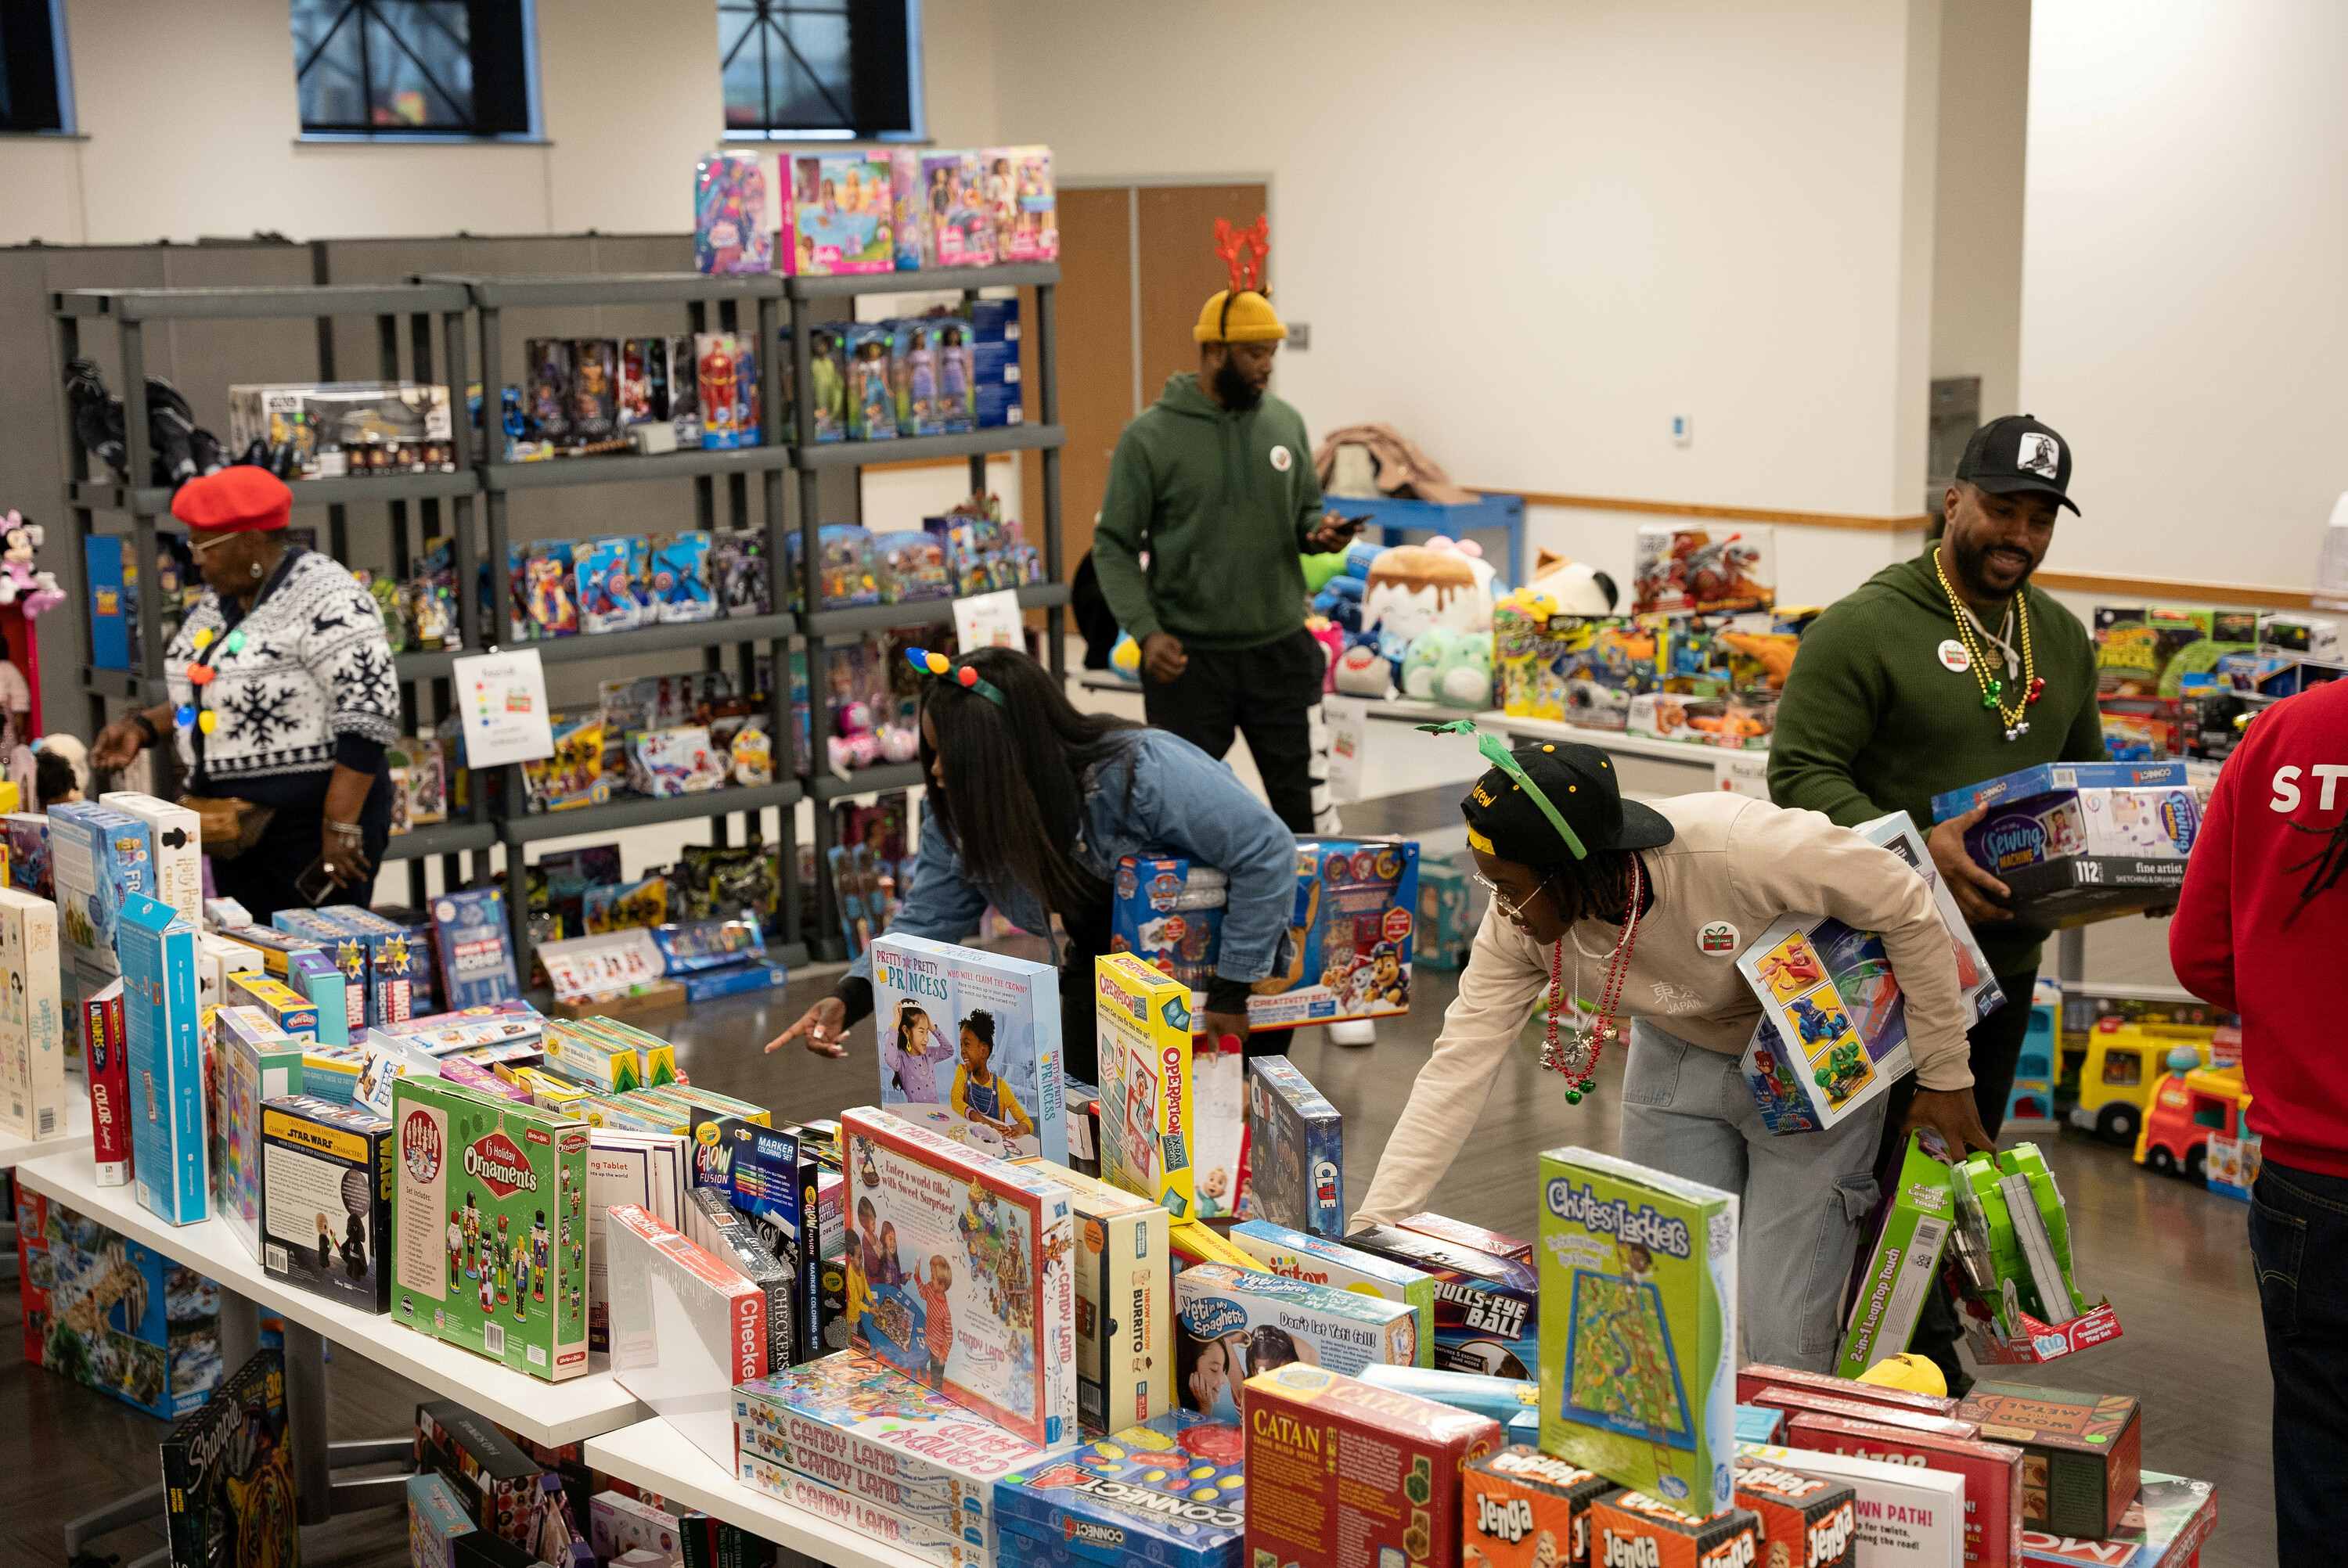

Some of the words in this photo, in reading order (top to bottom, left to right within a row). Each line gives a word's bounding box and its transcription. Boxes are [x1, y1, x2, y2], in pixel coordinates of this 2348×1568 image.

[1473, 781, 1496, 807] drew
[2167, 789, 2190, 855] Sewing
[1987, 825, 2045, 858] Sewing
[1999, 848, 2034, 868] MACHINE
[2076, 861, 2099, 883] 112
[2136, 862, 2154, 873] fine
[2157, 863, 2183, 874] artist
[2116, 875, 2149, 884] SKETCHING
[877, 950, 902, 966] PRETTY
[913, 958, 938, 975] PRETTY
[888, 966, 948, 1000] PRINCESS
[946, 969, 959, 978] WHO
[961, 971, 973, 980] WILL
[976, 975, 992, 985] CLAIM
[994, 978, 1003, 987] THE
[1005, 981, 1027, 994] CROWN?
[1100, 973, 1133, 1015] OPERATION
[347, 984, 363, 1027] MARVEL
[378, 981, 387, 1026] CROCHET
[394, 980, 411, 1023] MARVEL
[1667, 1000, 1702, 1015] JAPAN
[93, 1084, 113, 1125] COLOR
[1041, 1064, 1055, 1121] PRINCESS
[1055, 1087, 1064, 1109] PRETTY
[1162, 1047, 1181, 1136] OPERATION
[287, 1128, 310, 1142] STAR
[310, 1135, 333, 1149] WARS
[333, 1145, 362, 1158] CHARACTERS
[486, 1139, 492, 1156] 6
[494, 1144, 516, 1164] Holiday
[556, 1142, 590, 1153] Ornaments
[758, 1136, 794, 1155] MARKER
[758, 1145, 781, 1159] COLORING
[783, 1153, 793, 1162] SET
[1164, 1137, 1172, 1160] MATCH
[1172, 1138, 1182, 1166] X-RAY
[463, 1145, 538, 1193] Ornaments
[603, 1162, 628, 1171] Tablet
[697, 1143, 733, 1174] GLOW
[700, 1174, 729, 1185] FUSION
[885, 1159, 905, 1178] Enter
[910, 1174, 931, 1190] world
[932, 1180, 950, 1199] filled
[1313, 1162, 1338, 1209] CLUE
[413, 1190, 432, 1202] includes:
[881, 1176, 897, 1189] with
[898, 1180, 919, 1201] Sweet
[920, 1190, 956, 1216] Surprises!
[1908, 1189, 1947, 1205] LeapTop
[1914, 1198, 1941, 1211] Touch
[803, 1203, 818, 1229] GLOW
[1547, 1180, 1613, 1232] Chutes
[1617, 1202, 1689, 1257] Ladders
[1241, 1273, 1272, 1287] Yeti
[1059, 1271, 1071, 1321] CANDY
[1180, 1295, 1208, 1321] Yeti
[1209, 1304, 1215, 1312] in
[1217, 1302, 1227, 1311] My
[1434, 1280, 1526, 1321] BULLS-EYE
[1849, 1325, 1871, 1363] 2-in-1
[1864, 1278, 1890, 1329] LeapTop
[1878, 1247, 1901, 1286] Touch
[774, 1287, 790, 1371] CHECKERS
[1133, 1289, 1143, 1353] BURRITO
[1194, 1310, 1244, 1335] Spaghetti
[1280, 1311, 1309, 1332] Don't
[1312, 1319, 1327, 1336] let
[1328, 1323, 1351, 1341] Yeti
[1352, 1330, 1377, 1348] fall!
[1466, 1307, 1522, 1340] BALL
[958, 1329, 983, 1352] CANDY
[985, 1343, 1005, 1362] LAND
[1059, 1325, 1072, 1364] LAND
[2035, 1334, 2066, 1354] KID
[2085, 1335, 2100, 1343] Play
[1451, 1355, 1463, 1364] GAME
[1464, 1359, 1479, 1368] MODES
[1460, 1354, 1482, 1363] EXCITING
[266, 1371, 282, 1396] 30
[1330, 1383, 1434, 1426] CATAN
[1253, 1409, 1320, 1454] CATAN
[1998, 1414, 2073, 1431] WOOD
[188, 1396, 243, 1495] Sharpie
[790, 1418, 848, 1458] CANDY
[852, 1441, 898, 1476] LAND
[1252, 1435, 1273, 1448] TRADE
[1274, 1440, 1295, 1455] BUILD
[1295, 1448, 1320, 1463] SETTLE
[796, 1447, 852, 1486] CANDY
[857, 1470, 900, 1505] LAND
[795, 1480, 851, 1522] CANDY
[856, 1505, 900, 1541] LAND
[1076, 1476, 1245, 1527] CONNECT
[1856, 1500, 1882, 1519] WN
[1888, 1506, 1933, 1527] PATH!
[1075, 1523, 1124, 1544] CONNECT
[1476, 1492, 1534, 1545] Jenga
[1865, 1522, 1878, 1532] for
[1880, 1525, 1910, 1538] twists,
[1603, 1528, 1660, 1568] Jenga
[1807, 1505, 1854, 1568] Jenga
[1880, 1535, 1895, 1547] the
[1897, 1539, 1920, 1551] road!
